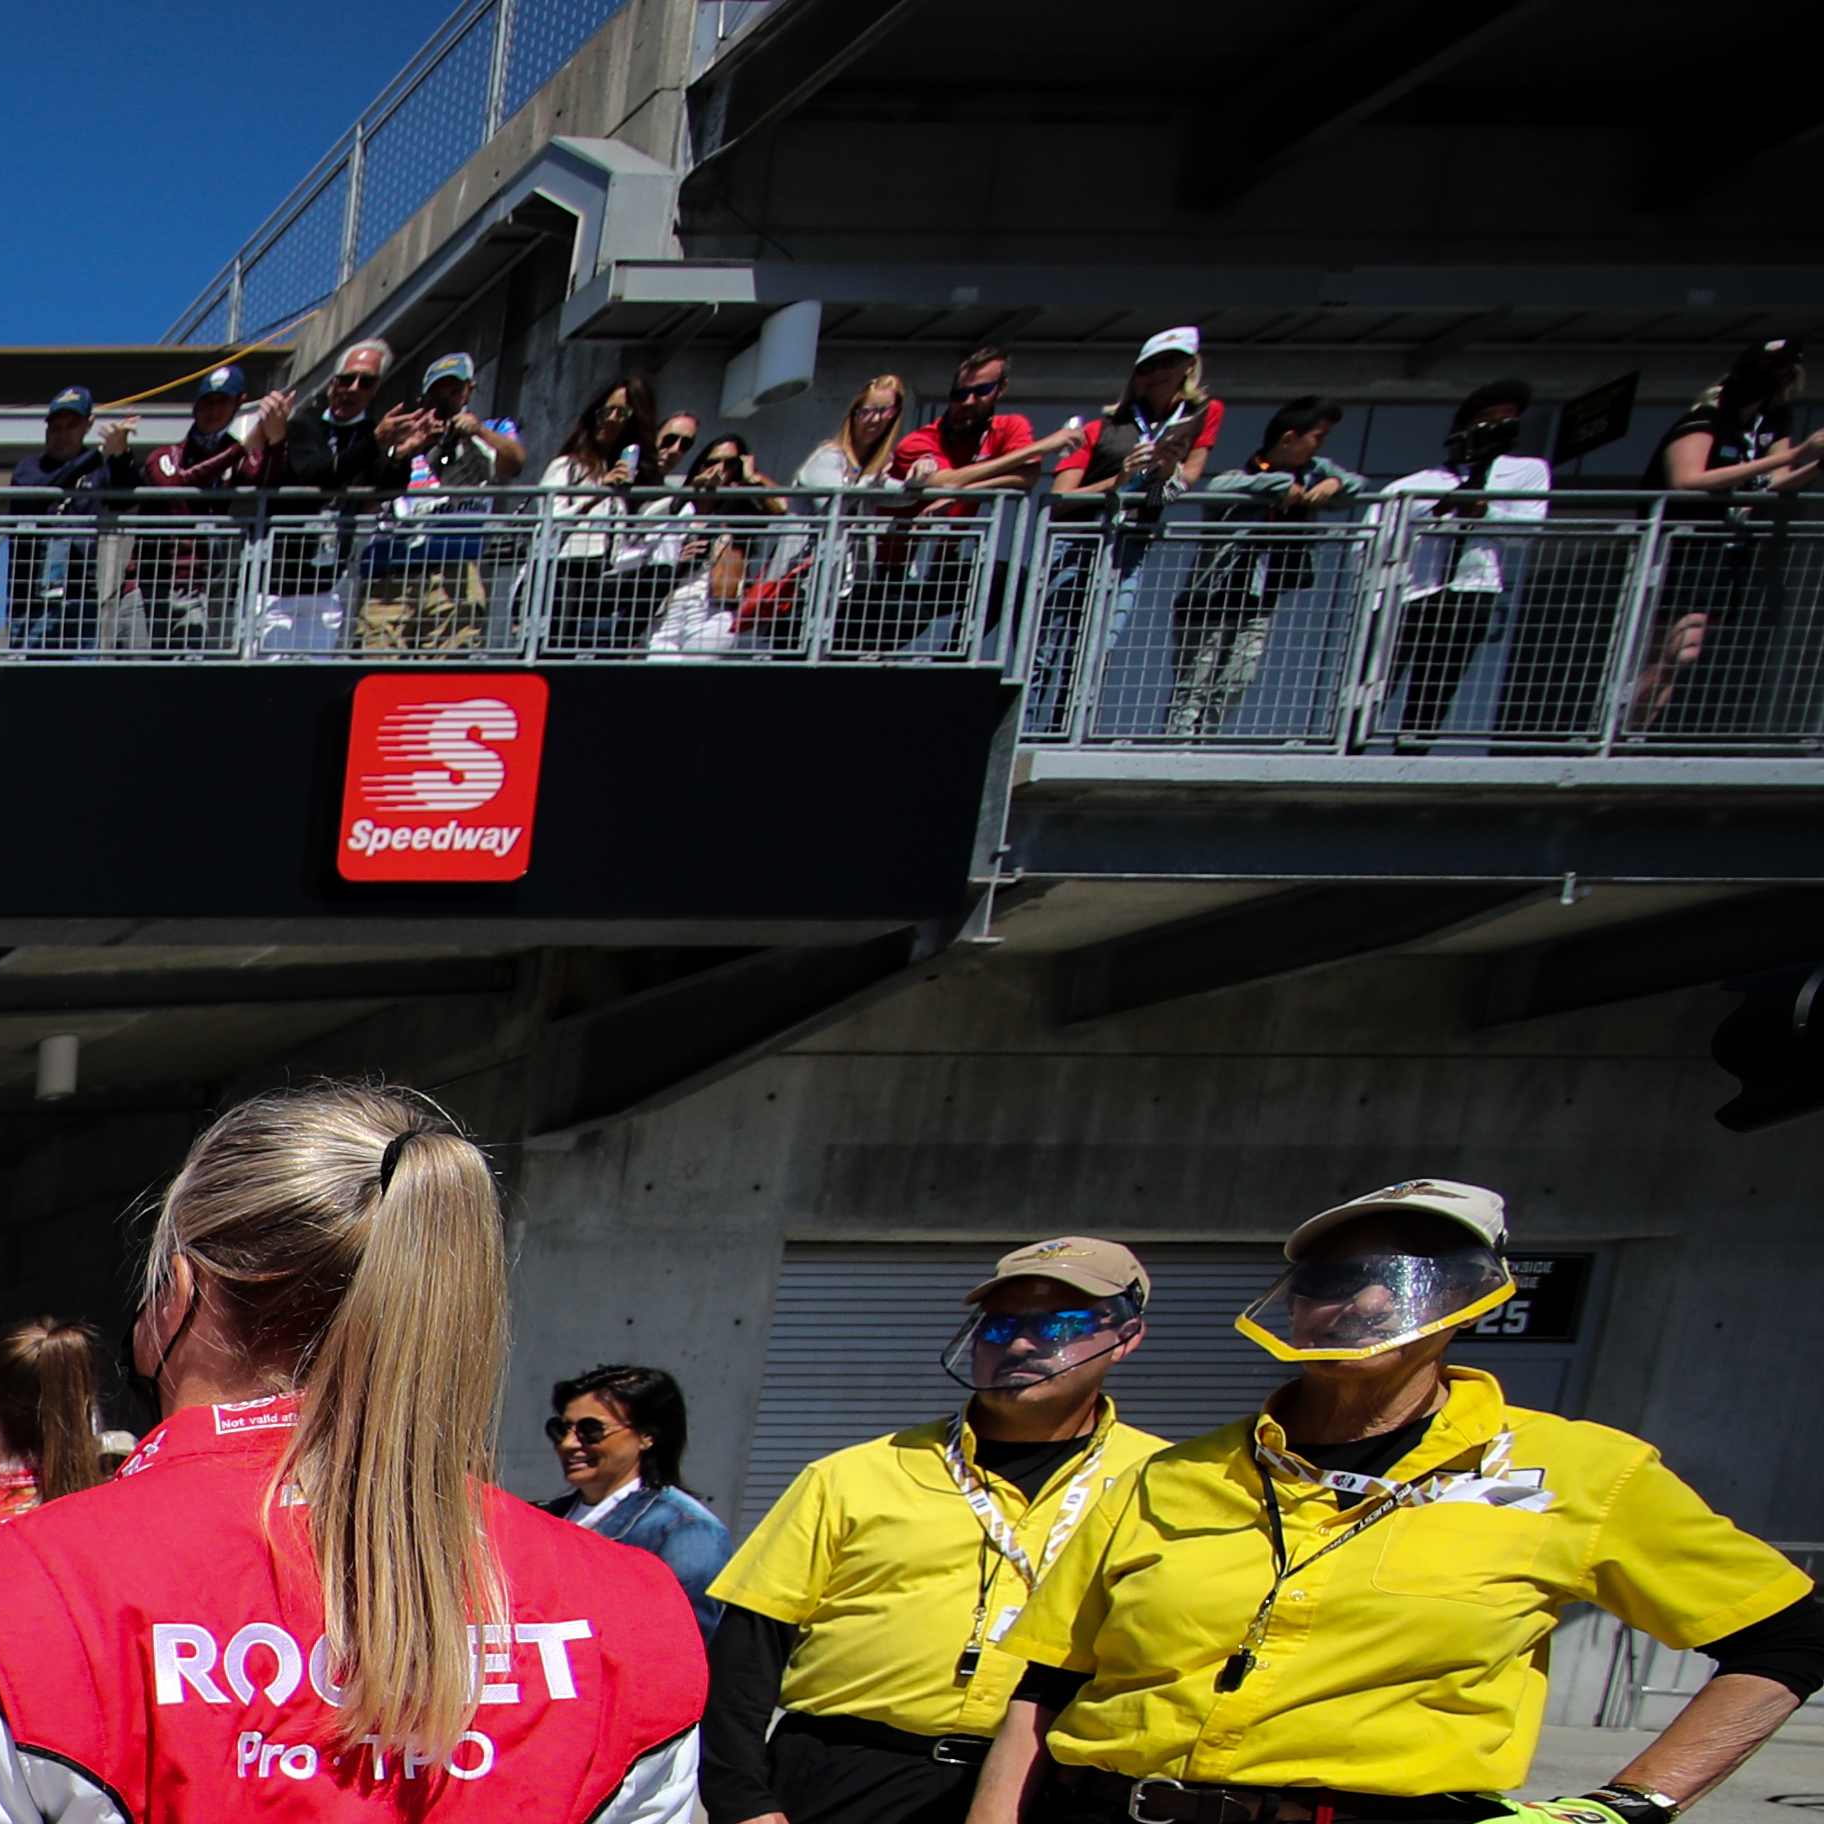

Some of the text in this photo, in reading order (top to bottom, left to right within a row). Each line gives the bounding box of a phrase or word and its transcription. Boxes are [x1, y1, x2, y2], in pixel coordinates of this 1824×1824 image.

[347, 818, 522, 858] Speedway
[1475, 1300, 1532, 1334] 25
[221, 1417, 245, 1429] Not
[249, 1413, 278, 1425] valid
[153, 1619, 592, 1708] ROET
[237, 1731, 318, 1779] Pro
